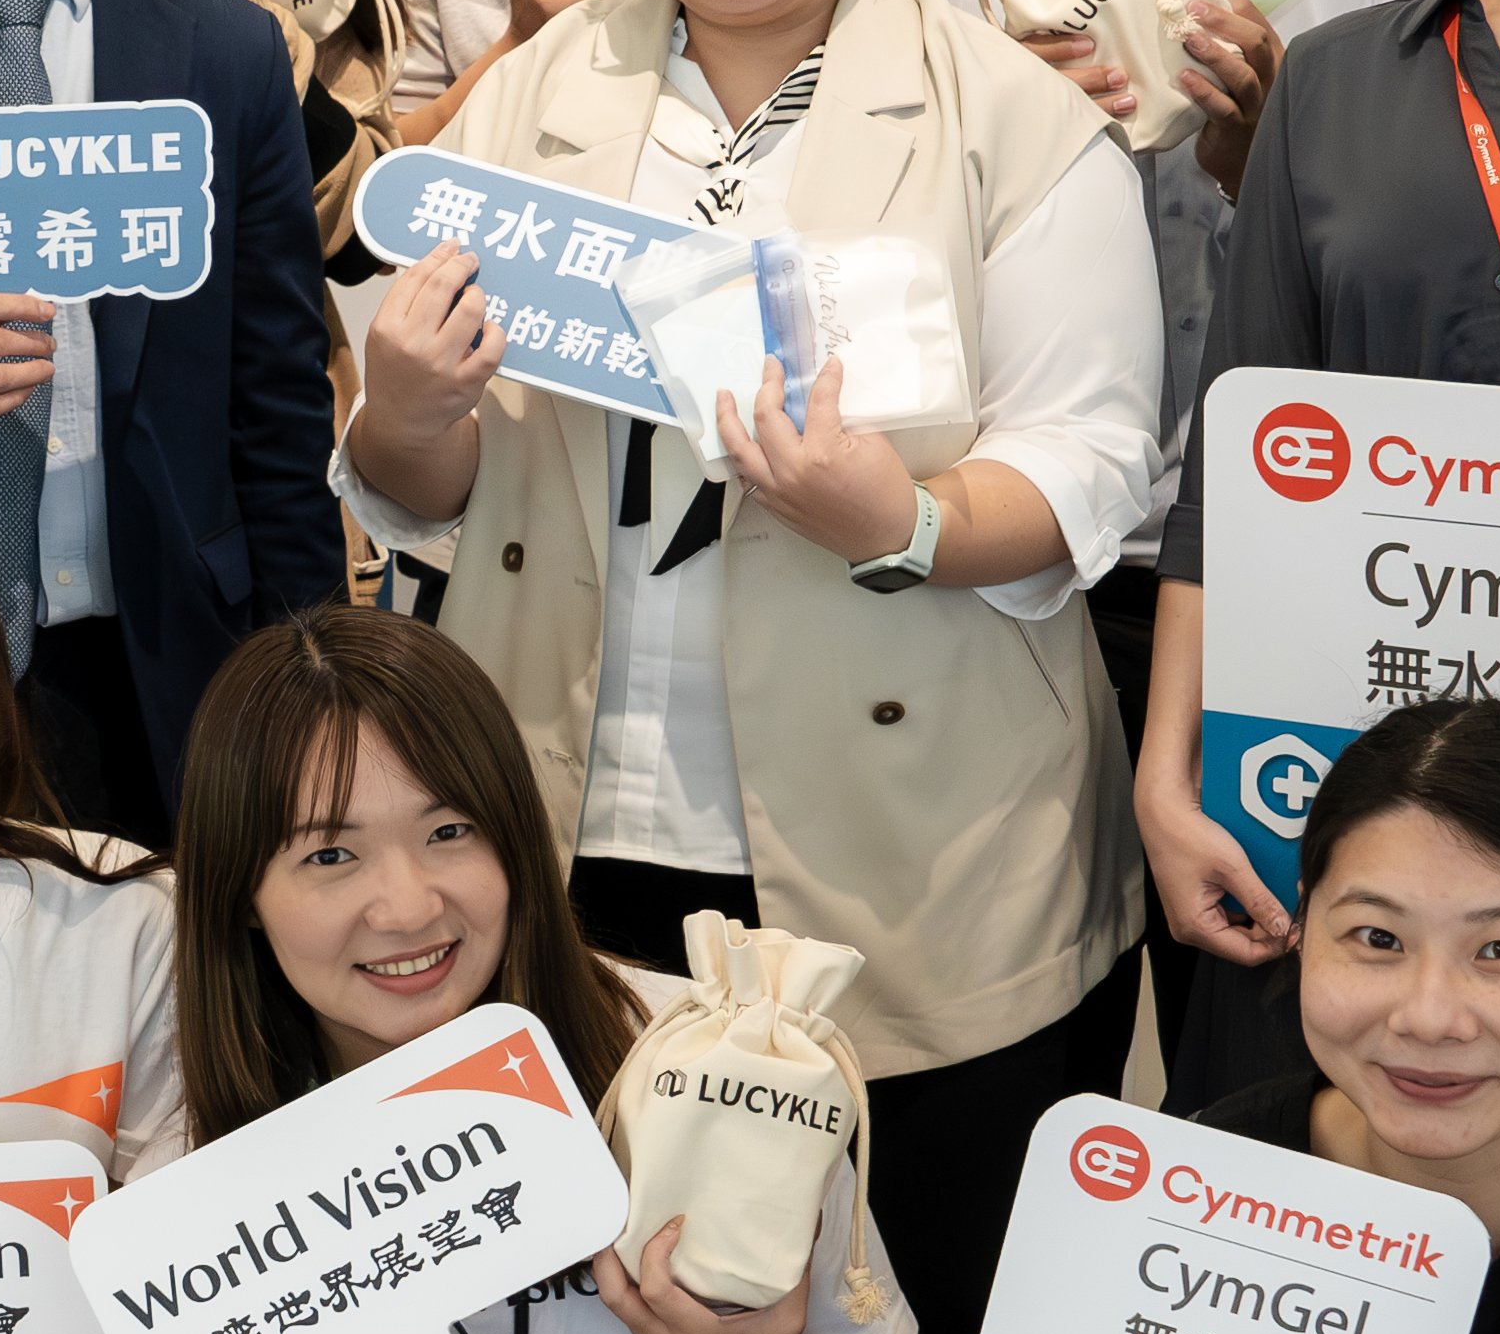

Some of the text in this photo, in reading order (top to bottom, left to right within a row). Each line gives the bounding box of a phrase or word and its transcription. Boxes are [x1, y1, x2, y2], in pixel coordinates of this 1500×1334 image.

[1475, 138, 1500, 186] Cymmetrik
[484, 294, 663, 385] 的新乾
[698, 1073, 842, 1136] LUCYKLE
[112, 1122, 507, 1331] World Vision
[1162, 1165, 1444, 1278] Cymmetrik
